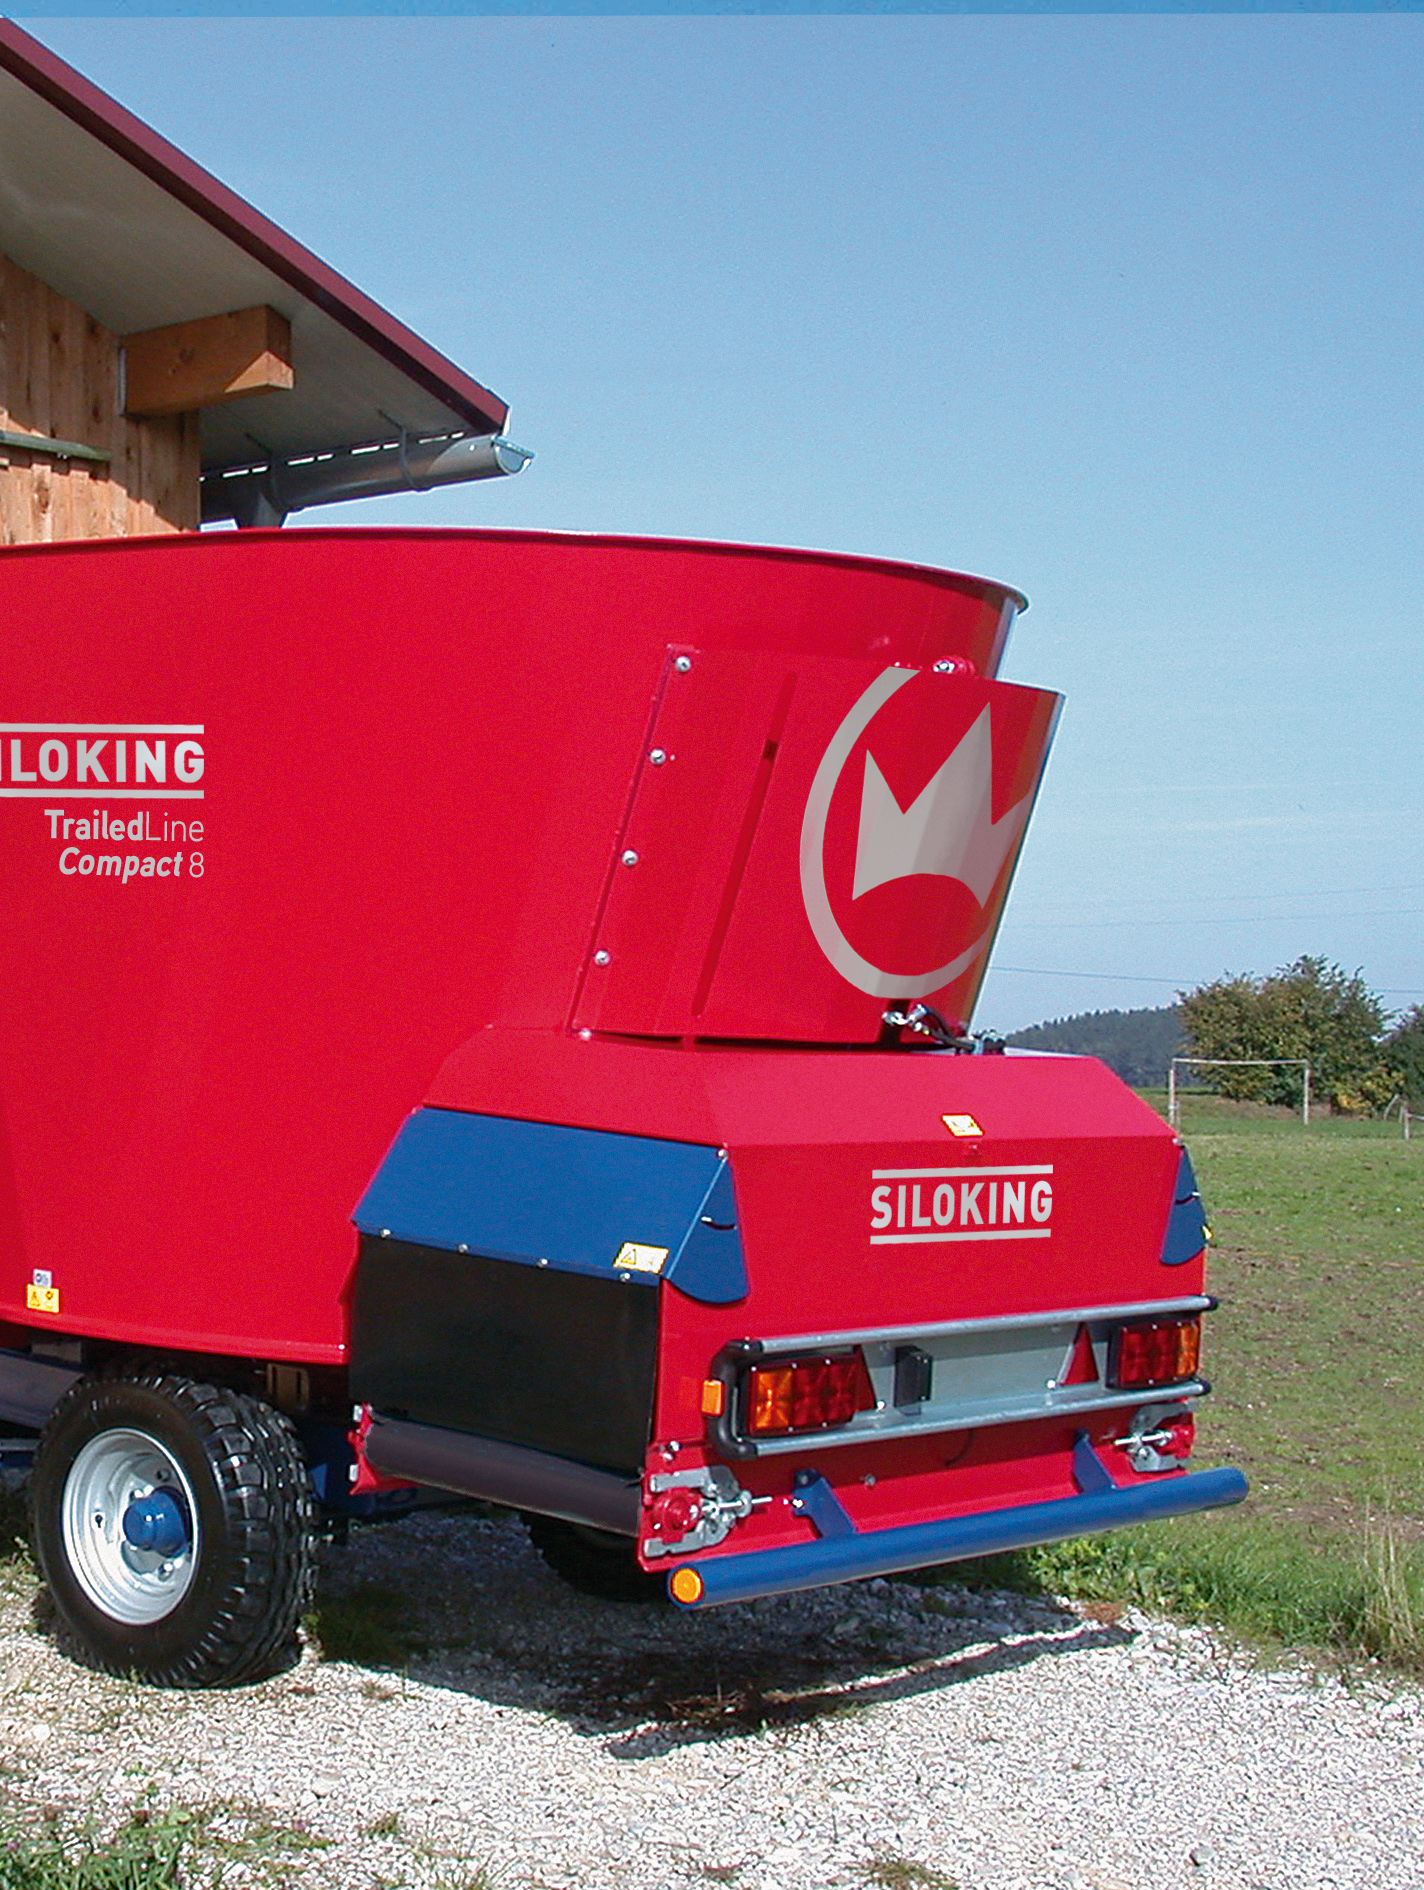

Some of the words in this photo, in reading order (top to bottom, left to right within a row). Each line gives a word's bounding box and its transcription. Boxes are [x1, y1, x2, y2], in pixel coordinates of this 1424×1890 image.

[44, 809, 205, 842] TrailedLine
[59, 846, 183, 884] Compact
[189, 851, 205, 878] 8
[870, 1180, 1053, 1229] SILOKING
